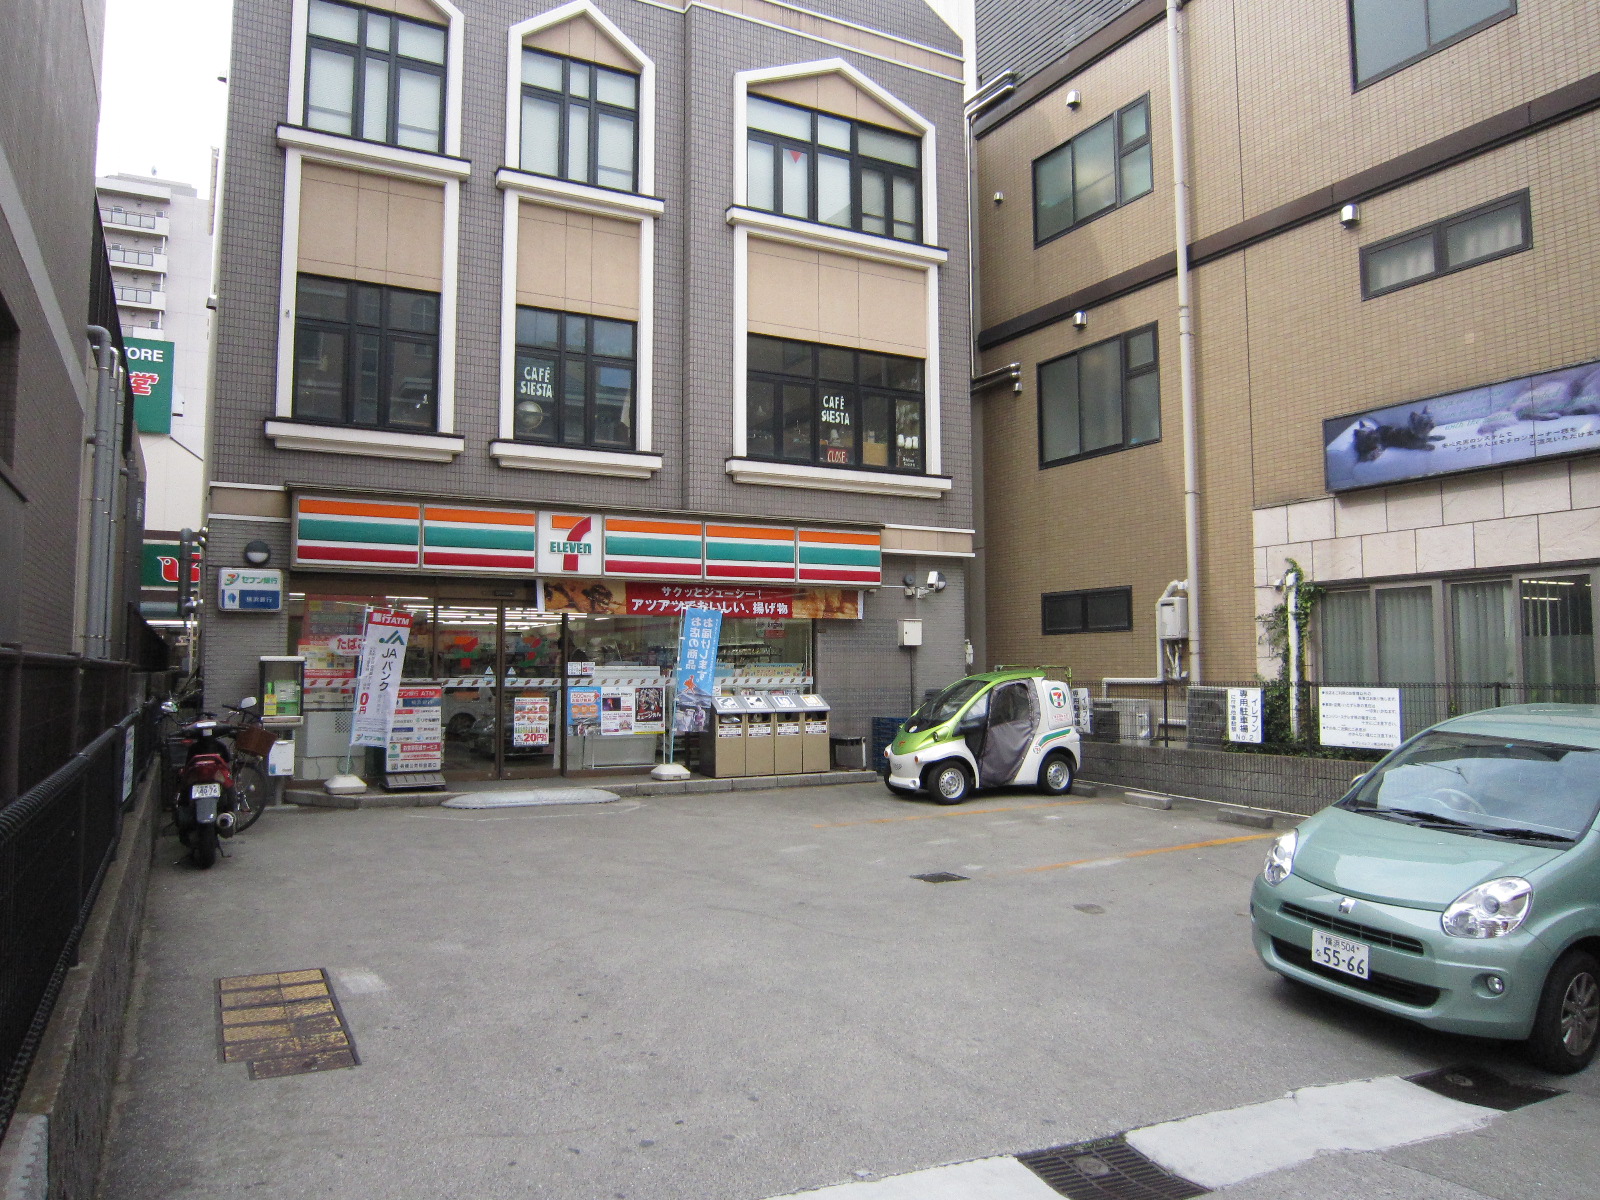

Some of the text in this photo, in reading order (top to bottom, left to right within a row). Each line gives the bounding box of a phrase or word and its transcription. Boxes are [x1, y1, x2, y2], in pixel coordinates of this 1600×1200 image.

[524, 366, 551, 383] CAFÉ
[520, 381, 553, 398] SIESTA
[821, 409, 850, 426] SIESTA
[241, 574, 278, 586] セブン銀行
[372, 611, 410, 626] 銀行ATM
[1323, 946, 1365, 975] 55-66
